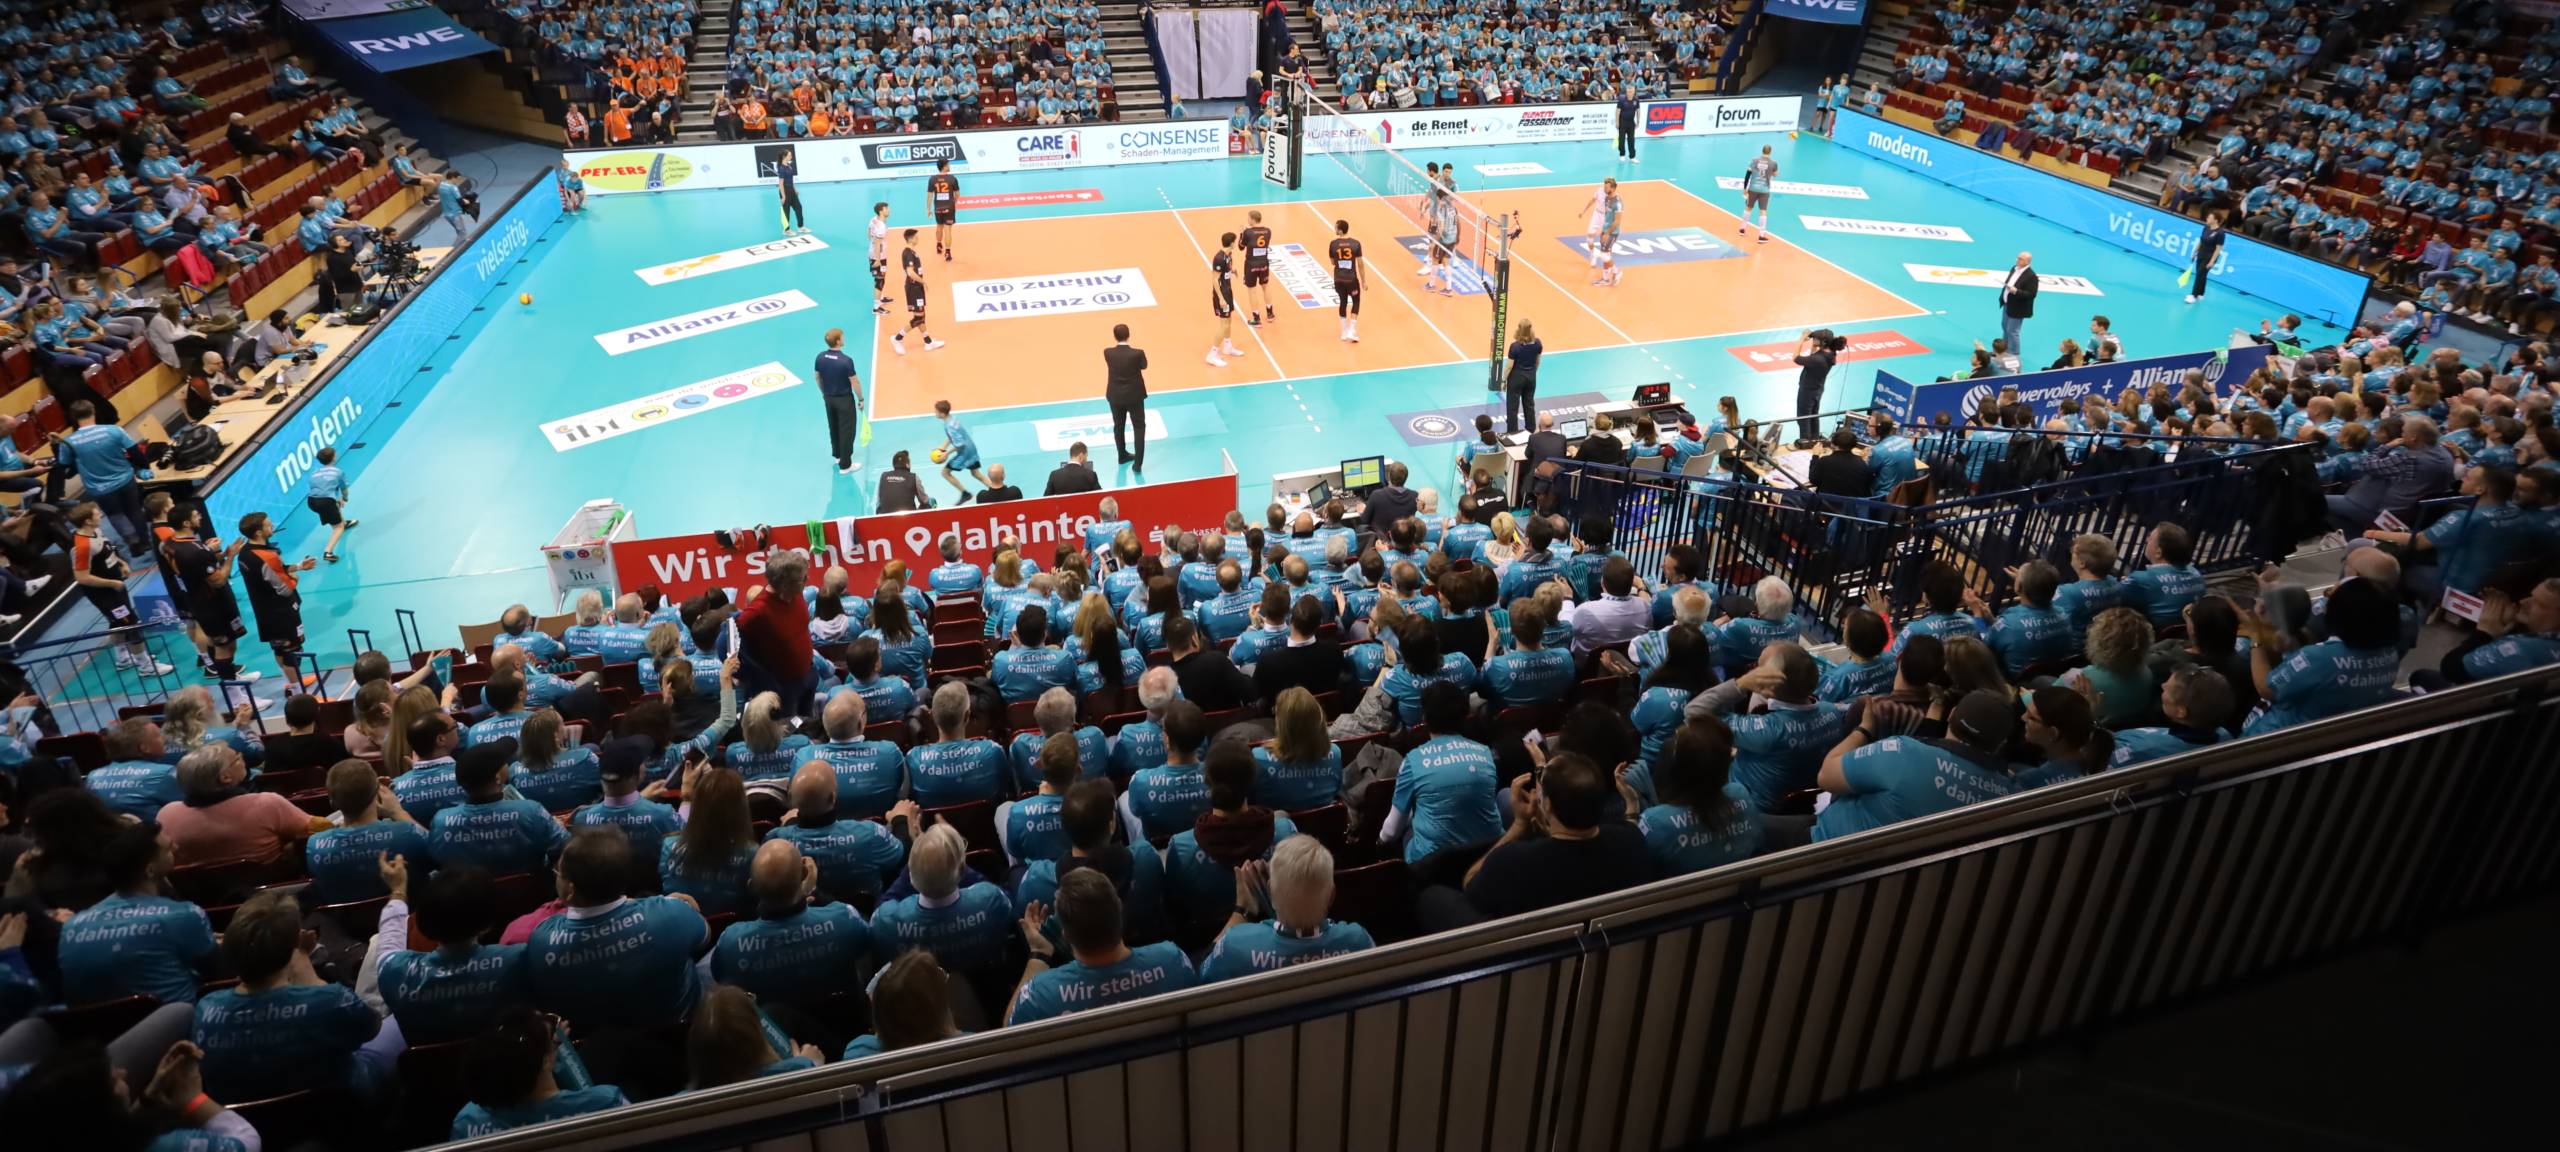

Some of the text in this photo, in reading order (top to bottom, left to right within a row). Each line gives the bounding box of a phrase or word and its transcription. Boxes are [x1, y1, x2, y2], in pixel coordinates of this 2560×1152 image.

[349, 26, 464, 54] RWE
[1411, 119, 1468, 131] de Renet
[1715, 105, 1761, 128] forum
[1017, 135, 1064, 152] CARE
[1120, 128, 1220, 148] CONSENSE
[883, 145, 951, 160] AM SPORT
[1121, 145, 1220, 158] Schaden-Management
[1868, 129, 1933, 168] modern.
[1265, 135, 1285, 184] forum
[934, 183, 949, 193] 12
[746, 237, 812, 257] EGN
[1256, 235, 1266, 247] 6
[476, 218, 530, 282] vielseitig.
[1335, 247, 1353, 260] 13
[1023, 274, 1123, 290] Allianz
[976, 296, 1085, 314] Allianz
[627, 311, 742, 344] Allianz
[1494, 292, 1506, 361] WWW.BIOFRUIT.DE
[1856, 338, 1906, 351] Düren
[2017, 380, 2093, 403] wervolleys
[2128, 367, 2186, 389] Allian
[275, 394, 363, 493] modern.
[648, 549, 729, 584] Wir
[938, 511, 1097, 552] dahinte
[2156, 574, 2177, 583] Wir
[1750, 625, 1767, 634] Wir
[1926, 619, 1947, 630] Wir
[2021, 617, 2041, 628] Wir
[1008, 653, 1057, 663] Wir stehen
[1508, 658, 1528, 669] Wir
[2332, 656, 2363, 670] Wir
[1848, 671, 1866, 683] Wir
[1785, 720, 1808, 733] Wir
[1136, 732, 1156, 743] Wir
[814, 746, 878, 760] Wir stehen
[920, 745, 981, 761] Wir stehen
[1420, 741, 1444, 756] Wir
[831, 761, 878, 774] ahinter.
[928, 761, 983, 777] dahinter.
[1936, 757, 1966, 781] Wir
[397, 773, 456, 791] Wir stehe
[1149, 772, 1204, 786] Wir steh
[1158, 786, 1211, 803] dahinte
[1025, 803, 1047, 815] Wir
[445, 810, 519, 827] Wir stehen
[586, 813, 605, 825] Wir
[315, 829, 393, 851] Wir stehen
[73, 903, 169, 925] Wir stehen
[75, 920, 163, 944] dahinter.
[550, 911, 645, 946] Wir stehen
[738, 919, 835, 953] Wir stehen
[897, 921, 925, 938] Wir
[559, 935, 653, 967] dahinter.
[1251, 949, 1286, 969] Wir
[1059, 964, 1165, 1001] Wir stehen
[201, 1002, 308, 1025] Wir stehen
